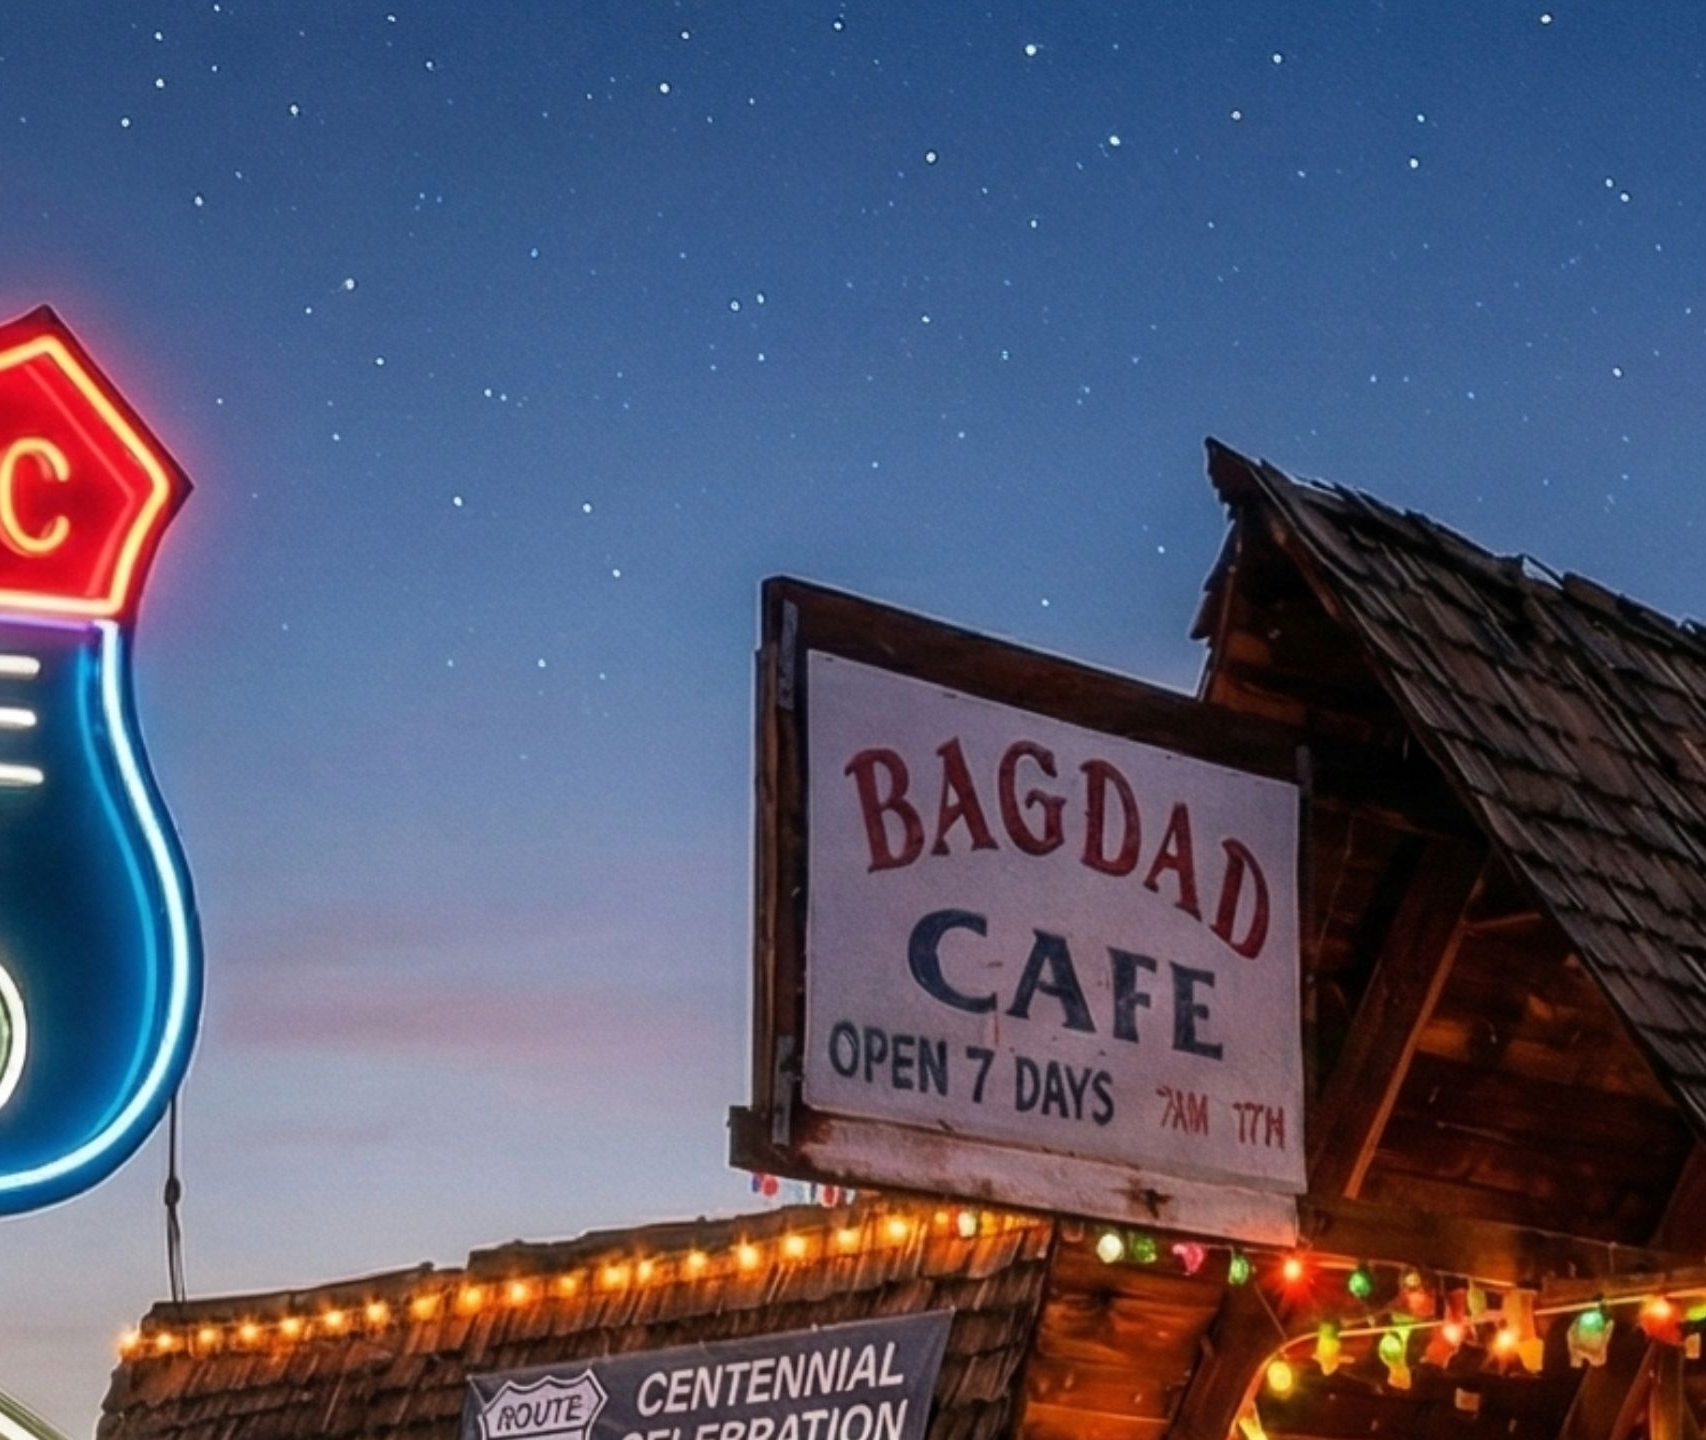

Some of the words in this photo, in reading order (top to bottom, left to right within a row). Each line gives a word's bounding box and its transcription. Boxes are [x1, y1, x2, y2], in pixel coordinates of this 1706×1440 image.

[843, 736, 1270, 961] BAGDAD
[906, 907, 1224, 1061] CAFE
[828, 1019, 949, 1096] OPEN
[966, 1047, 996, 1103] 7
[1015, 1056, 1115, 1126] DAYS
[497, 1396, 584, 1432] ROUTE
[637, 1342, 905, 1418] CENTENNIAL
